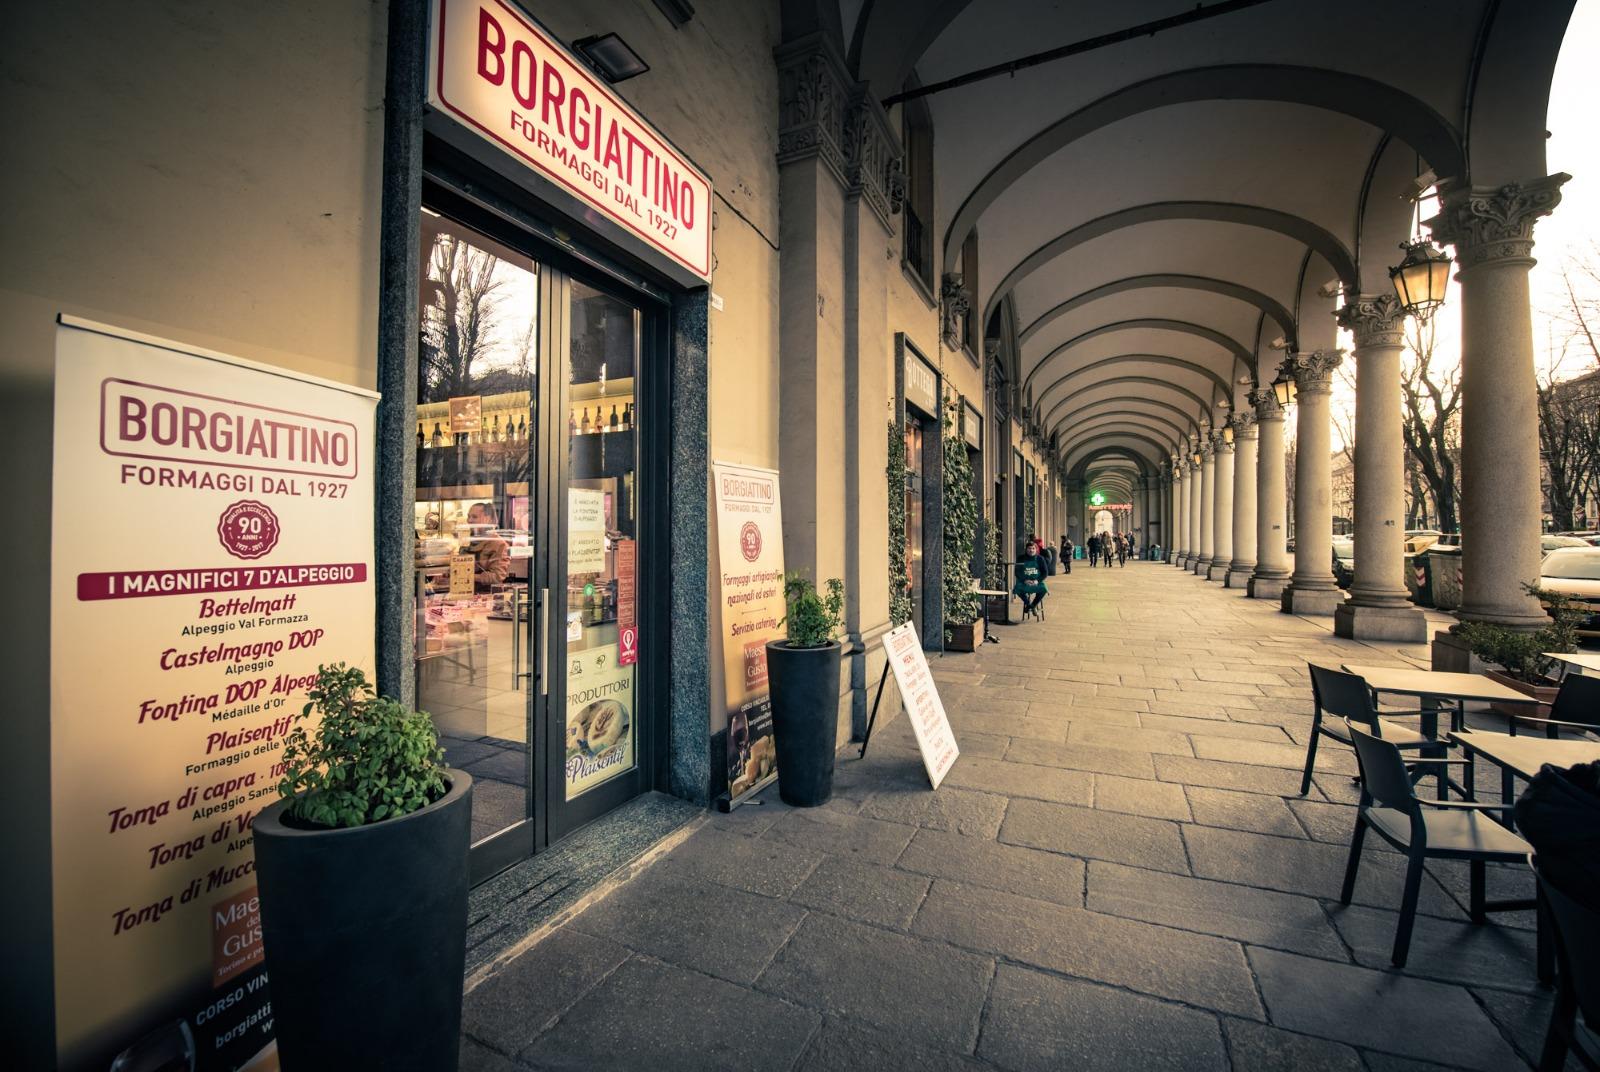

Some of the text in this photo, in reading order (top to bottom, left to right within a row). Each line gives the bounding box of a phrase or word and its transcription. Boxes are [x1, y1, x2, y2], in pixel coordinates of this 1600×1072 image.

[477, 6, 695, 230] BORGIATTINO
[510, 109, 678, 241] FORMAGGI DAL 1927
[118, 394, 349, 468] BORGIATTINO
[120, 463, 349, 499] FORMAGGI DAL 1927
[723, 478, 772, 500] BORGIATTINO
[724, 503, 750, 513] FORMAGGI
[238, 516, 262, 534] 90
[746, 532, 756, 545] 90
[107, 565, 355, 595] I MAGNIFICI 7 D'ALPEGGIO
[722, 569, 778, 586] Formaggi artigianal
[198, 593, 297, 619] Bettelmatt
[727, 585, 777, 607] nazionali ed esteri
[181, 613, 309, 637] Alpeggio Val Formazza
[731, 616, 777, 637] Servizio catering
[159, 628, 324, 671] Castelmagno DOP
[225, 658, 274, 675] Alpeggio
[747, 664, 767, 678] Gusto
[136, 694, 219, 724] Fontina
[225, 678, 267, 705] DOP
[212, 697, 286, 723] Médaille d'Or
[205, 713, 295, 755] Plaisentif
[185, 749, 251, 776] Formaggio
[253, 740, 280, 755] delle
[107, 802, 169, 835] Toma
[176, 786, 198, 811] di
[202, 771, 256, 800] capra
[192, 782, 278, 821] Alpeggio Sansi
[148, 837, 205, 870] Toma
[211, 820, 232, 845] di
[226, 837, 254, 854] Alpe
[111, 860, 257, 937] Toma di Mucc
[215, 896, 260, 931] Mae
[223, 925, 263, 957] Gus
[217, 956, 246, 977] Torino
[196, 971, 269, 1026] CORSO VIN
[215, 1001, 272, 1050] borgiatti
